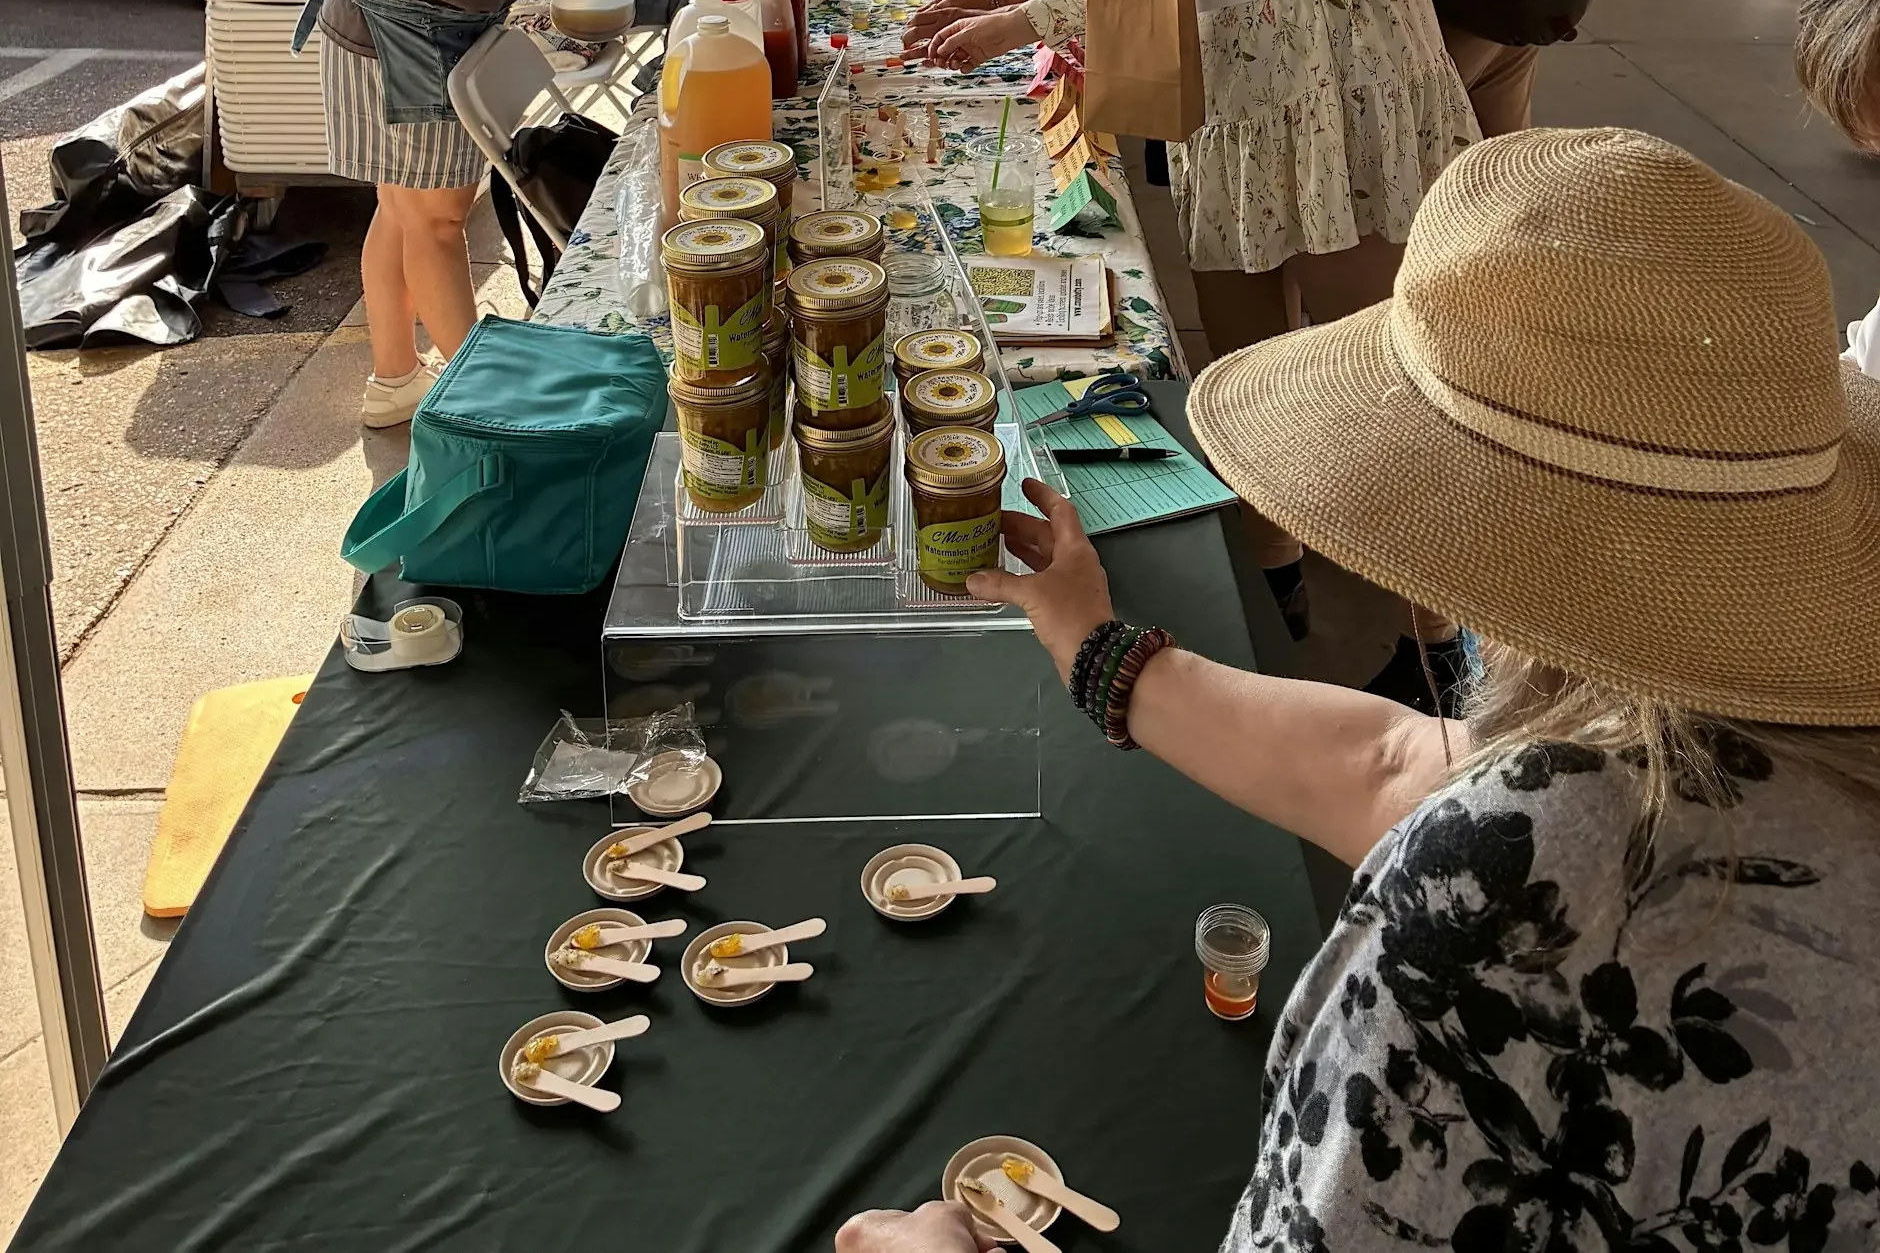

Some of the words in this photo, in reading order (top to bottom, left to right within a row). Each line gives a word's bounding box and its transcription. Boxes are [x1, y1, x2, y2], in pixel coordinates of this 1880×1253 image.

[932, 530, 971, 544] C'Mon
[972, 518, 996, 539] Betty
[925, 544, 969, 557] Watermelon
